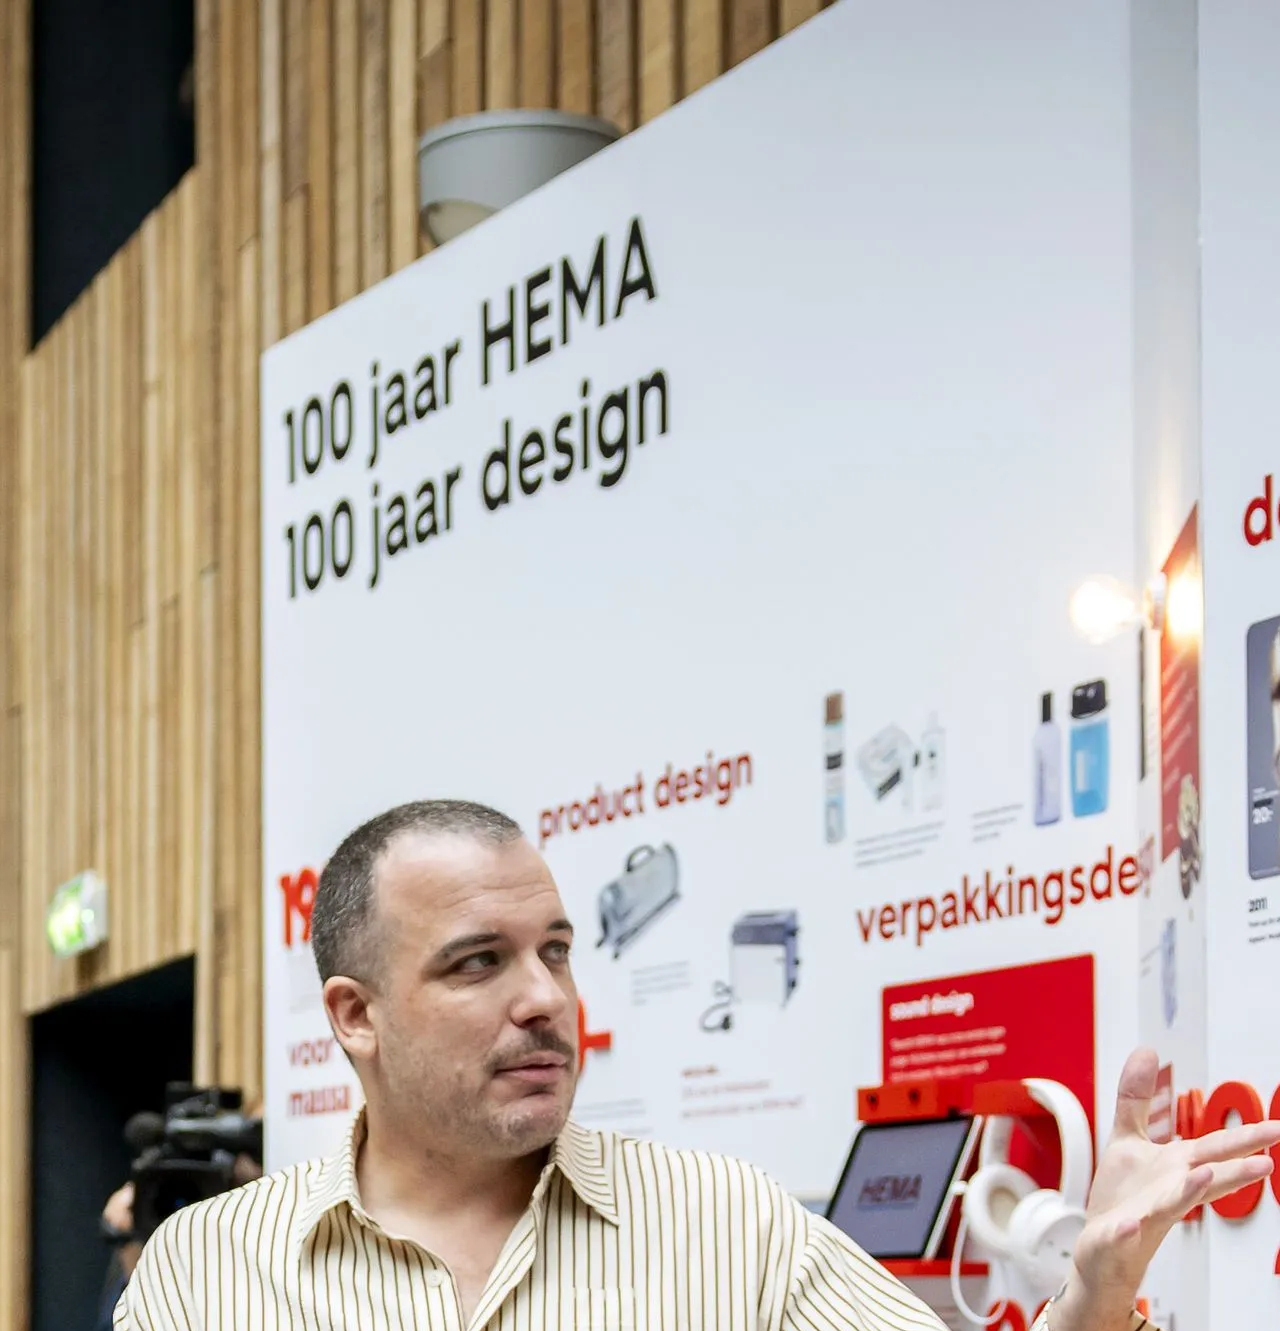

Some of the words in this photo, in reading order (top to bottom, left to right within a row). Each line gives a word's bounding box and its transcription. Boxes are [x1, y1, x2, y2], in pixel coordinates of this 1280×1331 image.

[284, 381, 353, 484] 100
[367, 338, 461, 468] jaar
[480, 215, 658, 386] HEMA
[284, 499, 354, 599] 100
[368, 466, 461, 589] jaar
[481, 368, 669, 512] design
[539, 772, 645, 848] product
[654, 751, 753, 808] design
